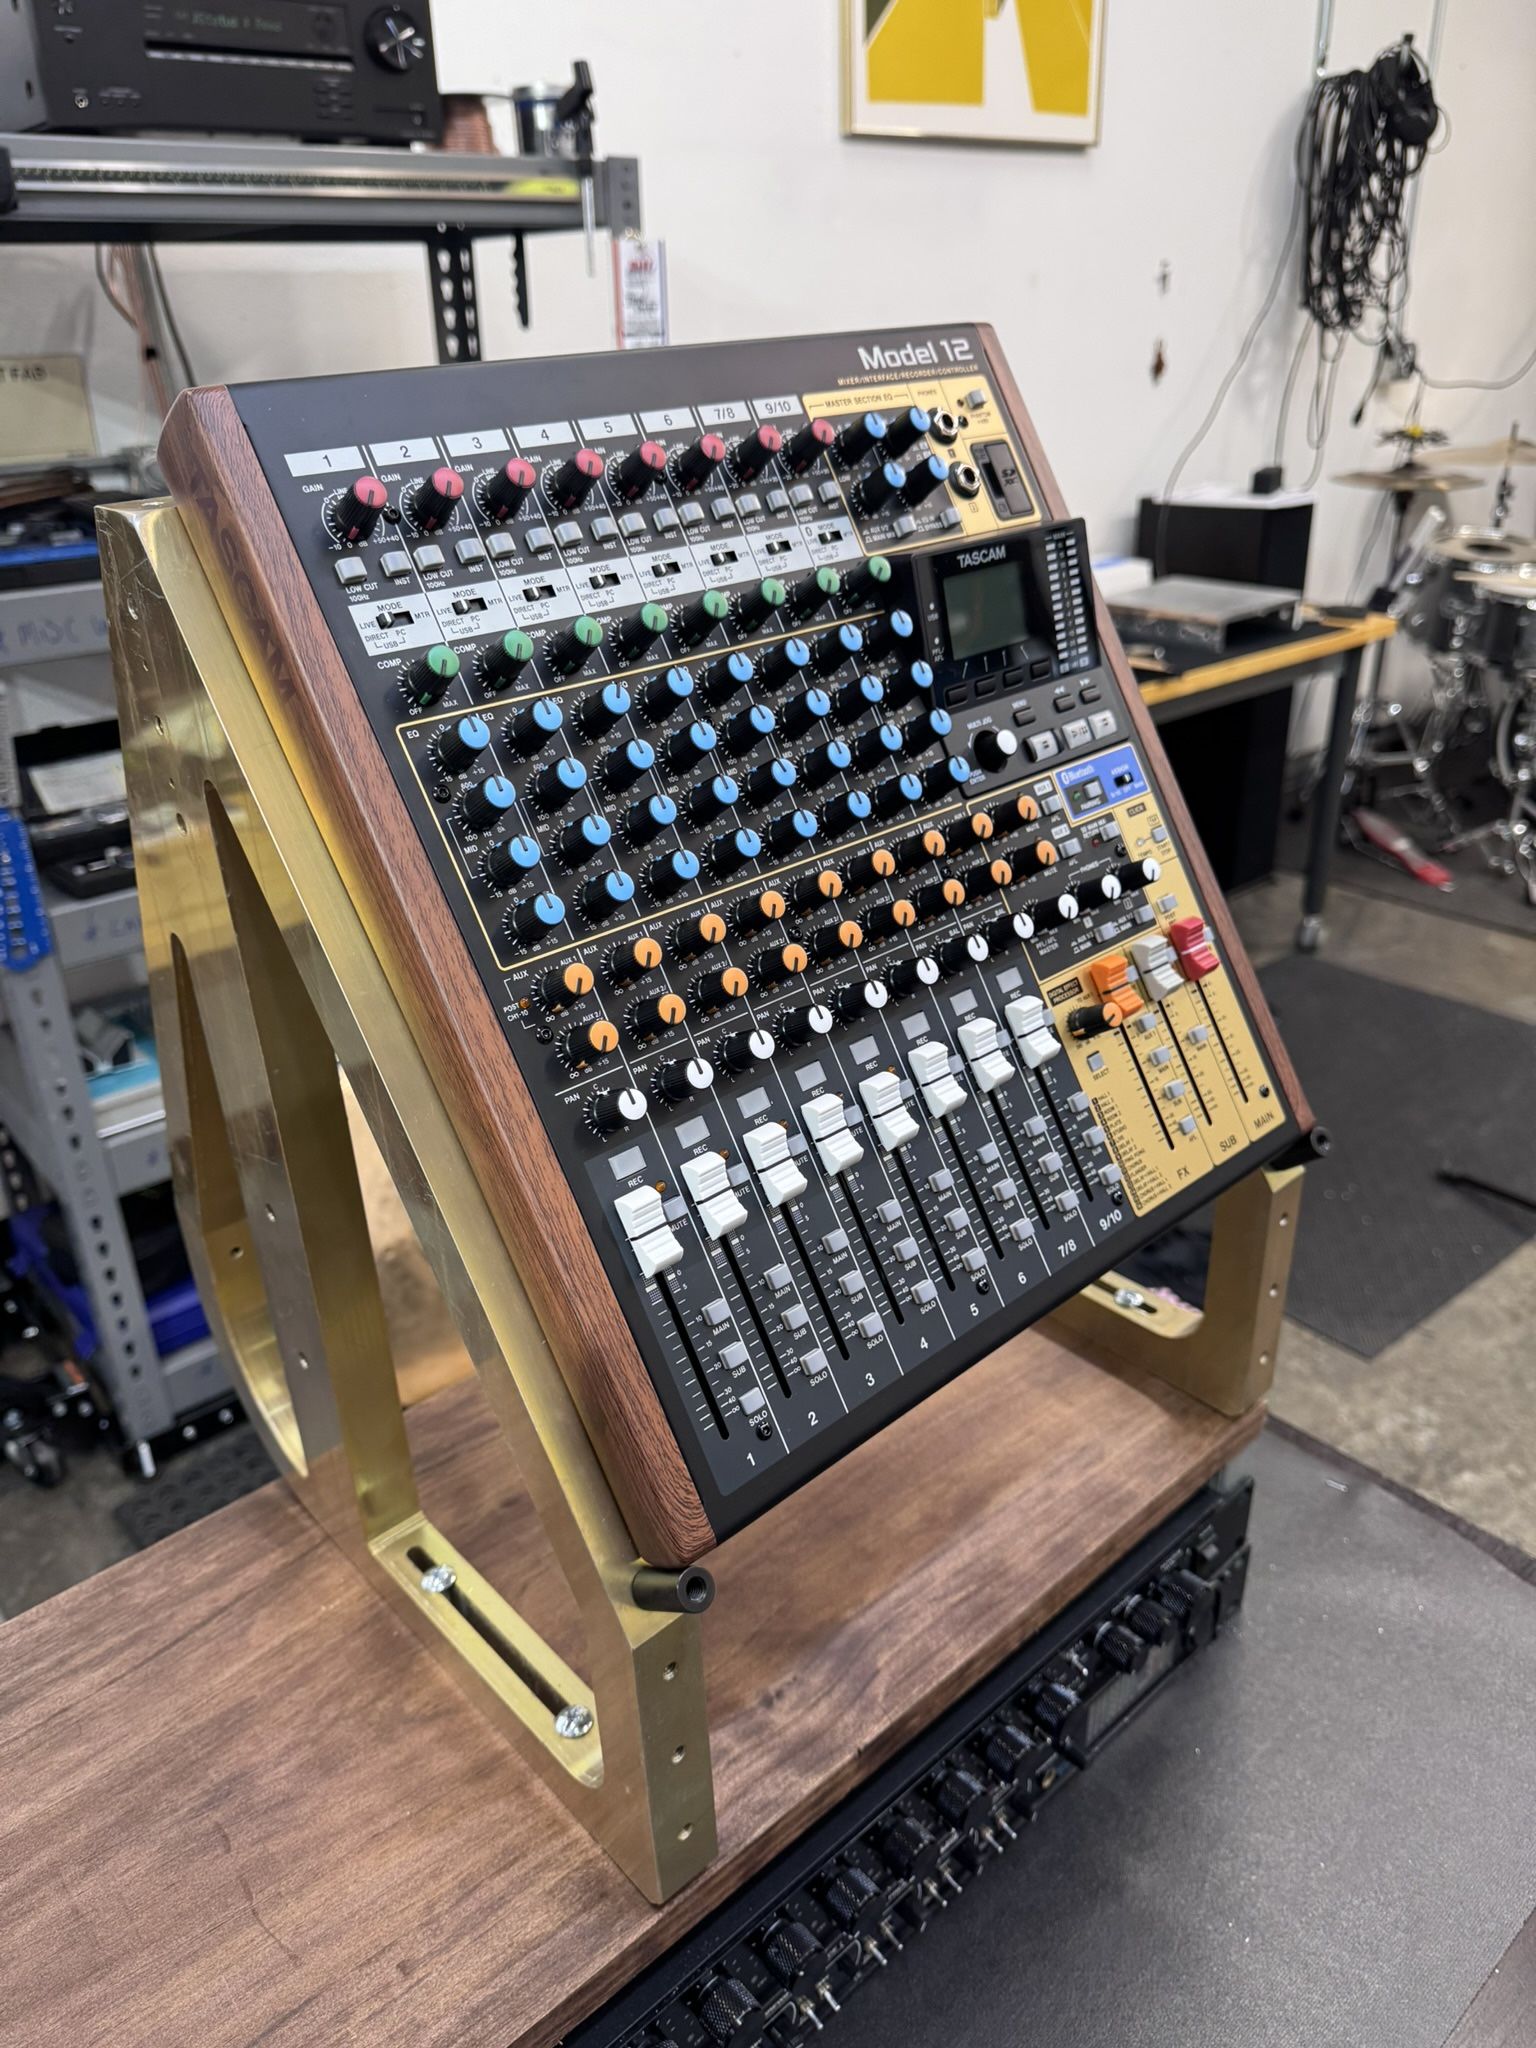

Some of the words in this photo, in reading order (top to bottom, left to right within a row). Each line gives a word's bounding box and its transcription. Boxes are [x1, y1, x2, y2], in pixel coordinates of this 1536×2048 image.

[858, 341, 938, 370] Model
[940, 338, 974, 360] 12
[838, 364, 978, 386] MIXER/INTERFACE/RECORDER/CONTROLLER
[825, 398, 852, 408] MASTER
[856, 395, 882, 404] SECTION
[765, 401, 791, 414] 9/10
[714, 407, 736, 420] 7/8
[664, 415, 672, 426] 6
[603, 422, 613, 433] 5
[541, 429, 549, 441] 4
[472, 437, 482, 449] 3
[400, 446, 411, 458] 2
[322, 455, 332, 467] 1
[454, 464, 474, 473] GAIN
[380, 473, 401, 482] GAIN
[302, 484, 324, 493] GAIN
[817, 522, 835, 531] MODE
[765, 532, 783, 540] MODE
[627, 538, 640, 546] LOW
[652, 553, 672, 562] MODE
[957, 545, 1006, 569] TASCAM
[469, 565, 484, 573] INST
[496, 560, 510, 568] LOW
[589, 564, 611, 573] MODE
[440, 570, 454, 578] CUT
[395, 577, 410, 585] INST
[523, 576, 547, 586] MODE
[345, 585, 362, 594] LOW
[363, 582, 378, 591] CUT
[452, 588, 477, 598] MODE
[508, 594, 523, 602] LIVE
[556, 585, 571, 594] MTR
[349, 594, 370, 602] 100Hz
[580, 592, 600, 601] DIRECT
[376, 602, 403, 612] MODE
[436, 607, 452, 616] LIVE
[487, 598, 504, 606] MTR
[513, 605, 535, 614] DIRECT
[359, 621, 376, 630] LIVE
[414, 611, 431, 620] MTR
[529, 611, 543, 620] USB
[441, 618, 464, 627] DIRECT
[459, 626, 473, 635] USB
[526, 629, 546, 639] COMP
[364, 632, 389, 642] DIRECT
[384, 640, 398, 649] USB
[453, 643, 478, 654] COMP
[377, 658, 402, 670] COMP
[554, 675, 566, 683] OFF
[583, 669, 597, 677] MAX
[484, 691, 497, 699] OFF
[515, 683, 530, 691] MAX
[408, 707, 423, 716] OFF
[442, 700, 458, 708] MAX
[482, 713, 495, 722] EQ
[407, 730, 420, 739] EQ
[603, 803, 617, 813] MID
[537, 813, 550, 821] 100
[536, 824, 550, 833] MID
[464, 833, 478, 842] 100
[874, 839, 886, 848] AUX
[463, 845, 478, 854] MID
[822, 858, 835, 868] AUX
[1080, 861, 1099, 874] PHONES
[710, 899, 724, 909] AUX
[649, 921, 663, 931] AUX
[962, 921, 975, 930] PAN
[546, 938, 559, 946] +15
[627, 933, 640, 942] AUX
[583, 944, 599, 955] AUX
[560, 957, 573, 966] AUX
[865, 964, 878, 973] PAN
[512, 970, 529, 981] AUX
[812, 987, 826, 996] PAN
[1010, 991, 1022, 999] REC
[503, 1003, 520, 1012] POST
[507, 1010, 529, 1022] CH1-10
[756, 1011, 770, 1021] PAN
[964, 1012, 977, 1022] REC
[696, 1036, 711, 1046] PAN
[916, 1036, 929, 1045] REC
[632, 1064, 648, 1074] PAN
[865, 1060, 878, 1071] REC
[1092, 1068, 1110, 1081] SELECT
[811, 1087, 825, 1097] REC
[564, 1093, 581, 1104] PAN
[754, 1114, 769, 1126] REC
[1253, 1112, 1275, 1129] MAIN
[1219, 1135, 1237, 1152] SUB
[692, 1144, 708, 1155] REC
[986, 1162, 1000, 1173] MAIN
[1177, 1167, 1190, 1180] FX
[627, 1176, 644, 1188] REC
[1106, 1183, 1120, 1195] SOLO
[1063, 1210, 1078, 1223] SOLO
[1099, 1210, 1123, 1231] 9/10
[887, 1221, 902, 1233] MAIN
[955, 1229, 968, 1240] SUB
[1018, 1239, 1033, 1252] SOLO
[1058, 1239, 1077, 1258] 7/8
[832, 1252, 848, 1264] MAIN
[904, 1261, 917, 1272] SUB
[970, 1269, 986, 1283] SOLO
[1017, 1272, 1027, 1284] 6
[774, 1286, 791, 1299] MAIN
[851, 1293, 864, 1305] SUB
[920, 1301, 937, 1314] SOLO
[970, 1303, 979, 1316] 5
[712, 1322, 730, 1336] MAIN
[793, 1328, 807, 1340] SUB
[866, 1335, 884, 1350] SOLO
[920, 1337, 929, 1350] 4
[731, 1366, 747, 1379] SUB
[809, 1371, 828, 1387] SOLO
[865, 1373, 875, 1387] 3
[724, 1386, 733, 1396] 30
[748, 1411, 768, 1427] SOLO
[808, 1411, 819, 1426] 2
[746, 1452, 756, 1466] 1
